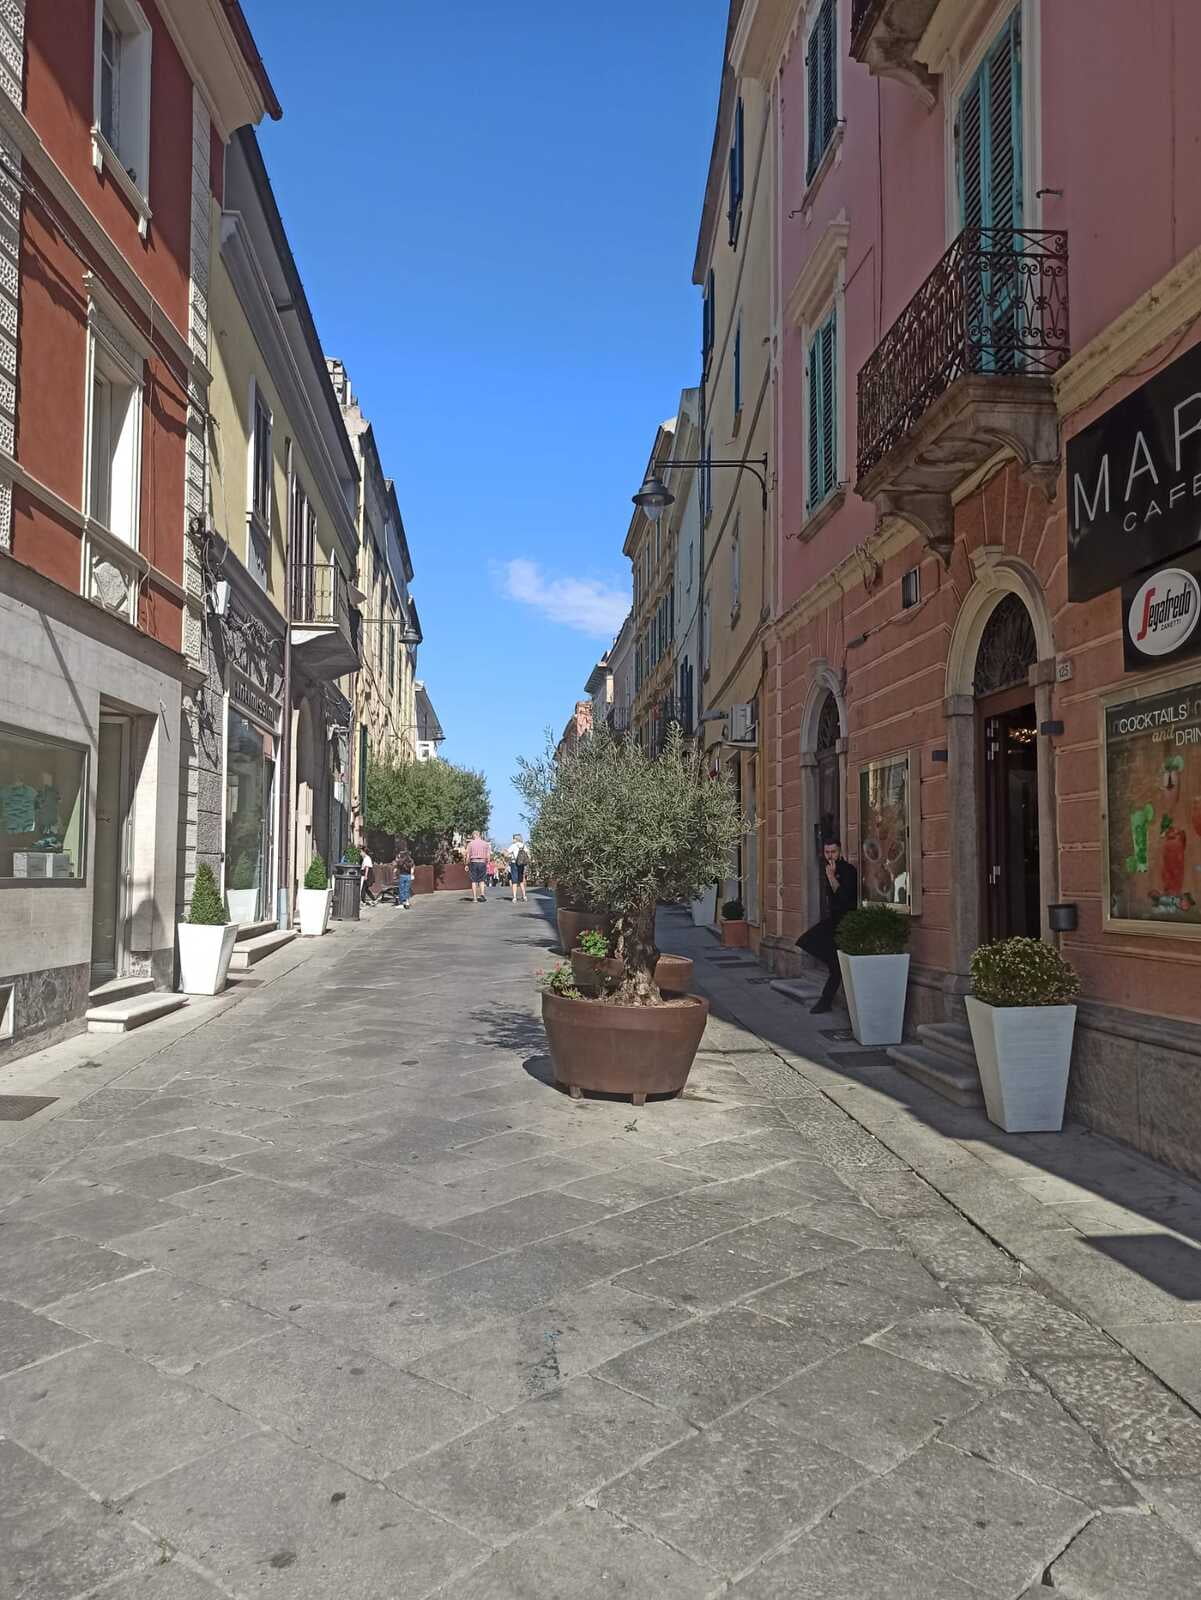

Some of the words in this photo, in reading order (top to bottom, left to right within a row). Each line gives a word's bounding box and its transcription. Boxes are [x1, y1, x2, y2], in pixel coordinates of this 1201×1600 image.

[1136, 582, 1192, 641] Segafredo
[1119, 703, 1188, 734] COCKTAILS
[1152, 725, 1175, 743] and
